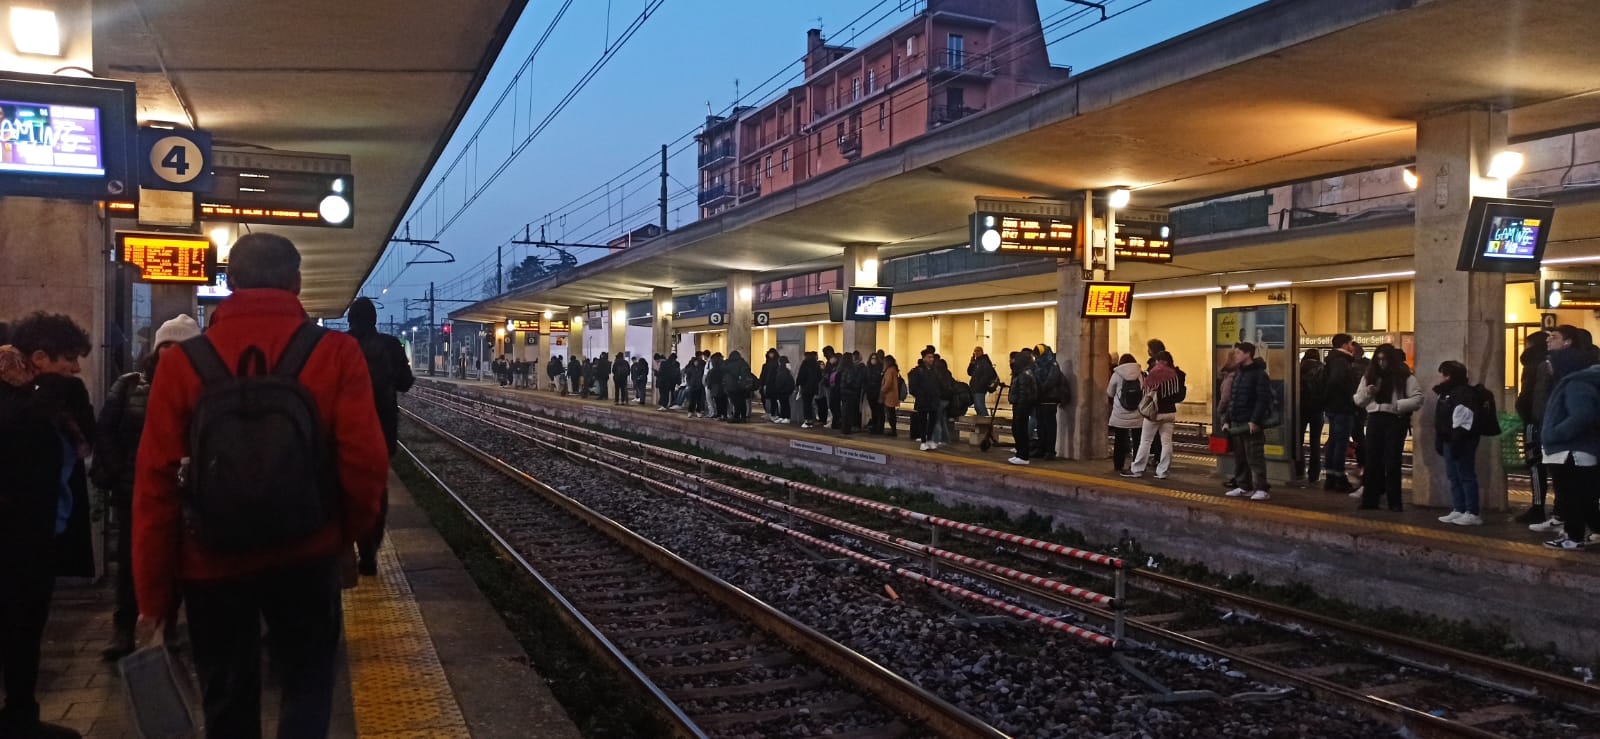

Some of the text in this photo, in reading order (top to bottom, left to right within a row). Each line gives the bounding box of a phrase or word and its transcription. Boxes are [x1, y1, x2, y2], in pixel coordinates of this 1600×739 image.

[161, 146, 190, 175] 4
[1306, 337, 1316, 345] Bar
[1318, 336, 1330, 344] Self
[1357, 335, 1384, 344] Bar Self
